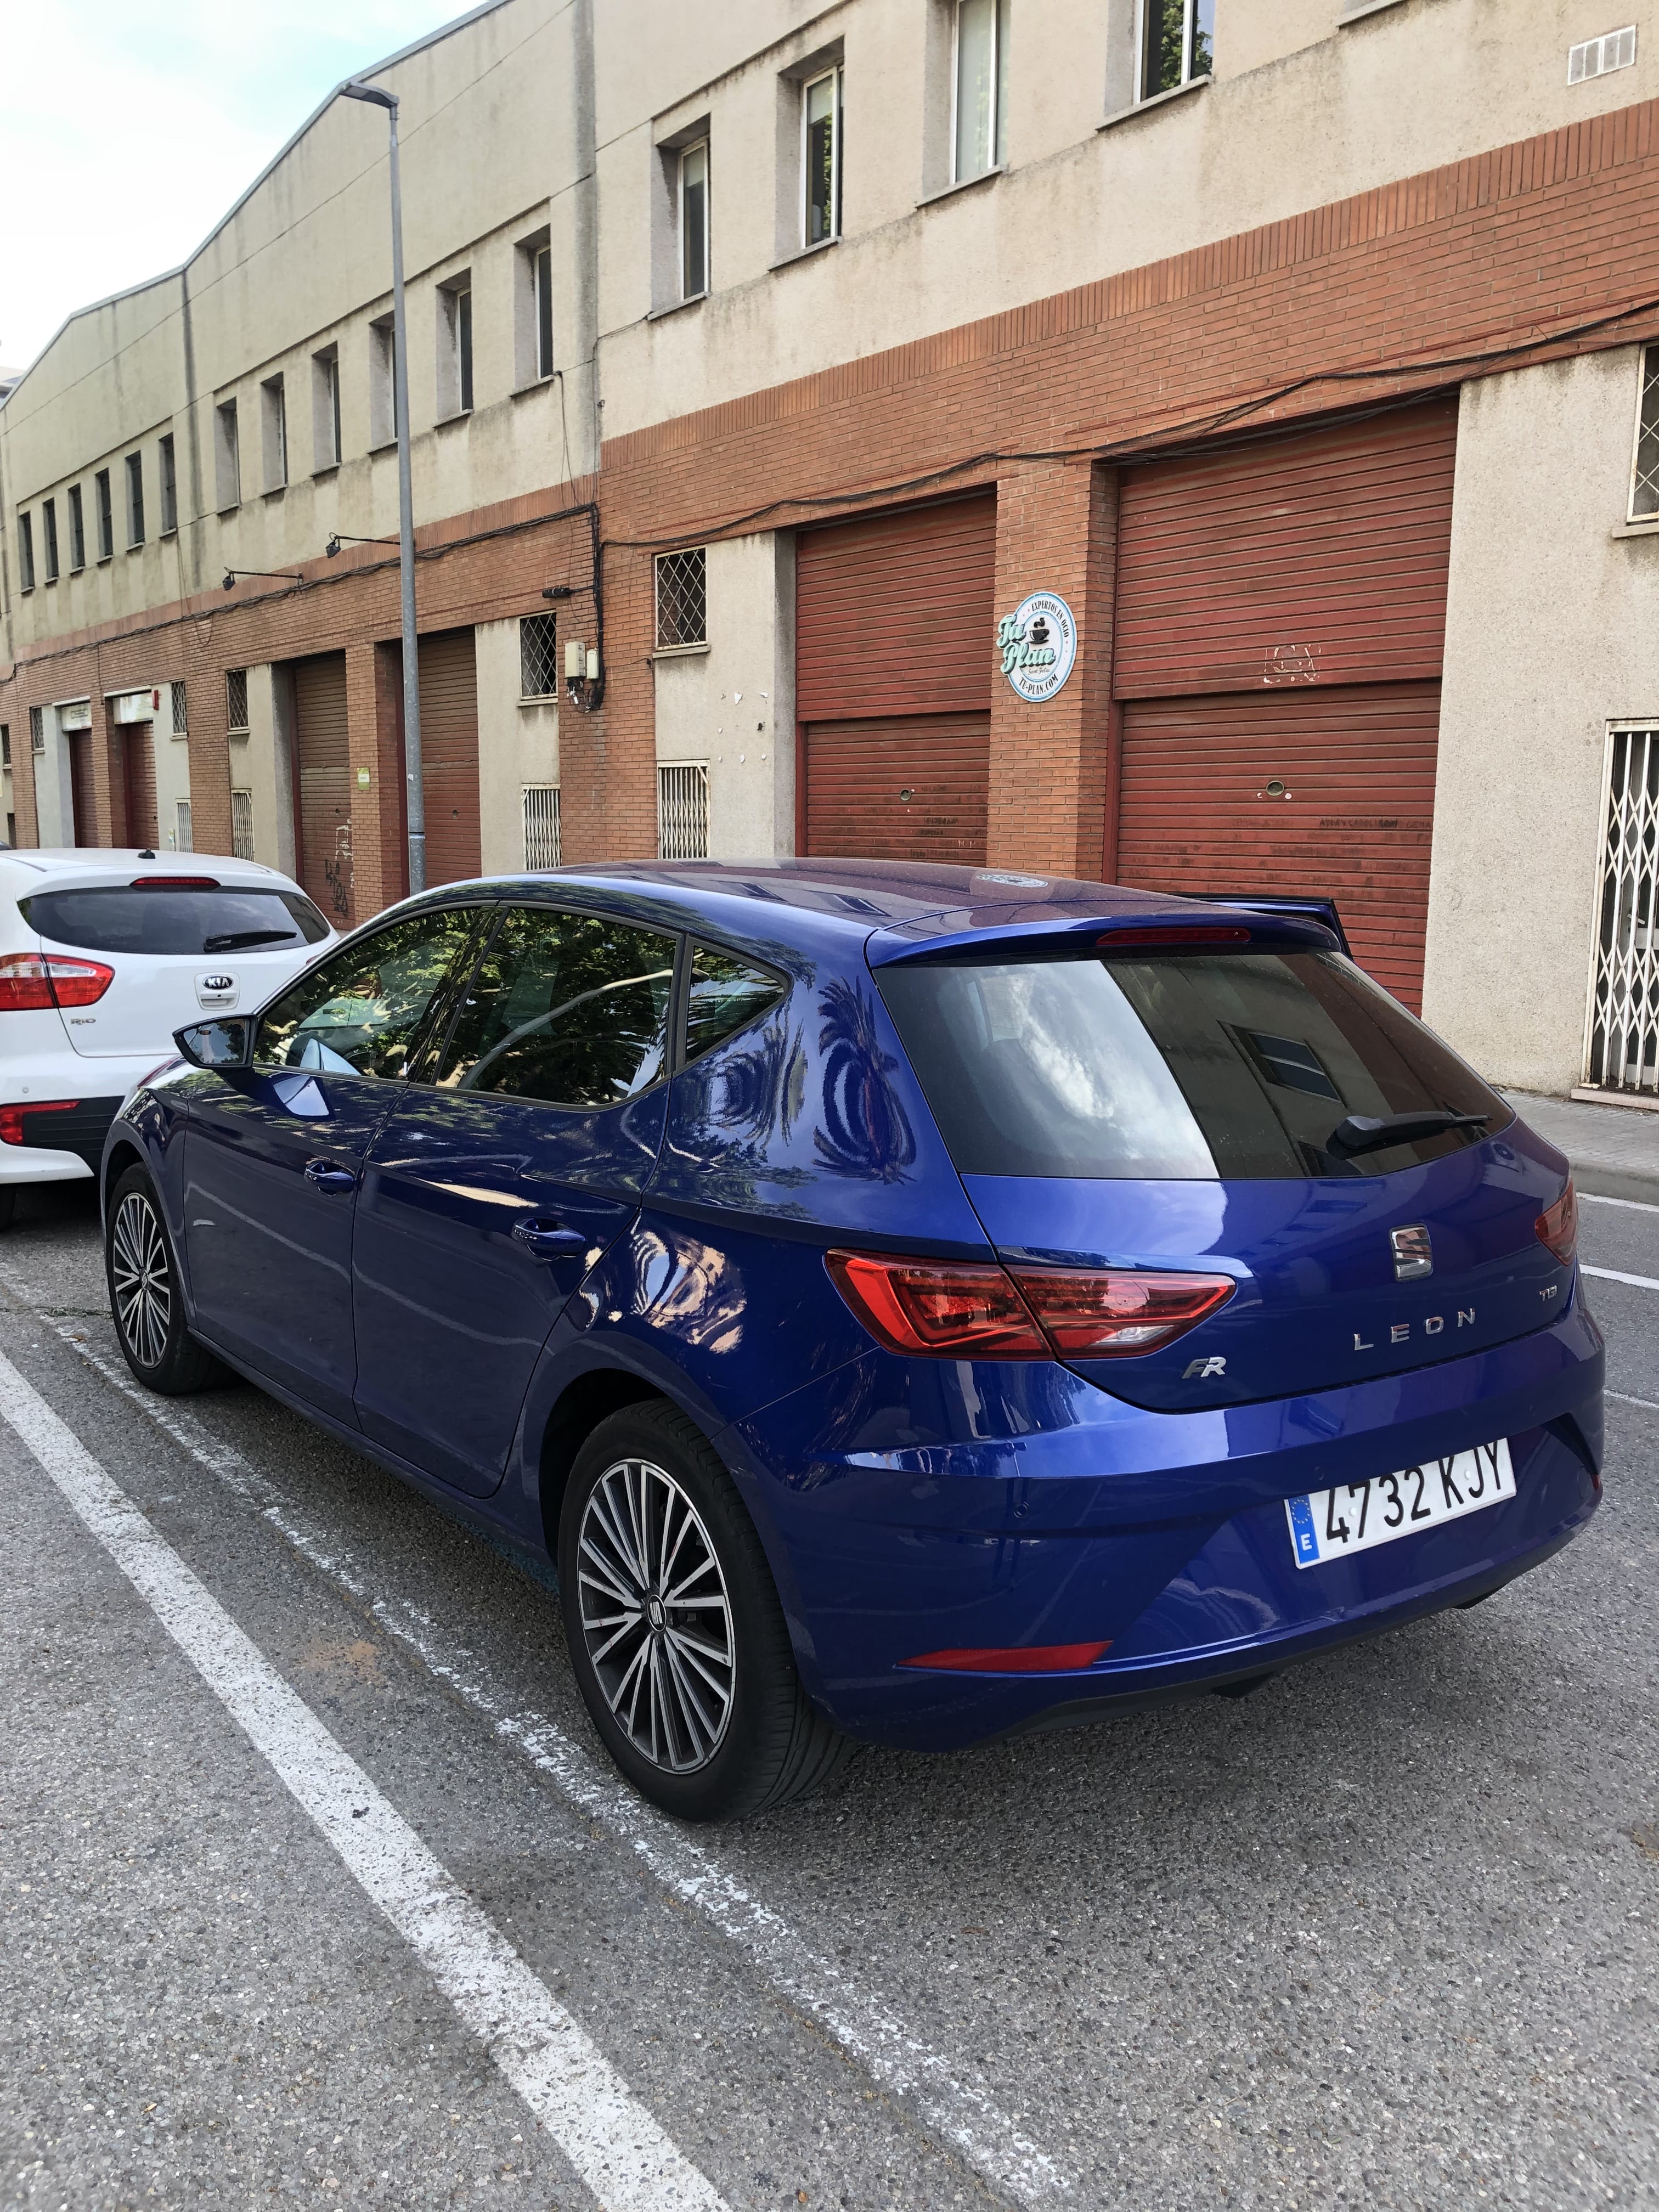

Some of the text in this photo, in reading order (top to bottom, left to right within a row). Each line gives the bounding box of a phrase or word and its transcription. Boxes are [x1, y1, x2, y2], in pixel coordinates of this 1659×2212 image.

[996, 614, 1027, 648] Tu
[1031, 600, 1069, 637] EXPERTOS EN OCIO
[1000, 640, 1056, 674] Plan
[1018, 674, 1059, 695] TU-PLAN.COM
[207, 978, 230, 988] KIA
[1353, 1307, 1476, 1351] LEON
[1181, 1356, 1227, 1379] FR
[1326, 1441, 1502, 1544] 4732 KJY
[1300, 1533, 1313, 1551] E
